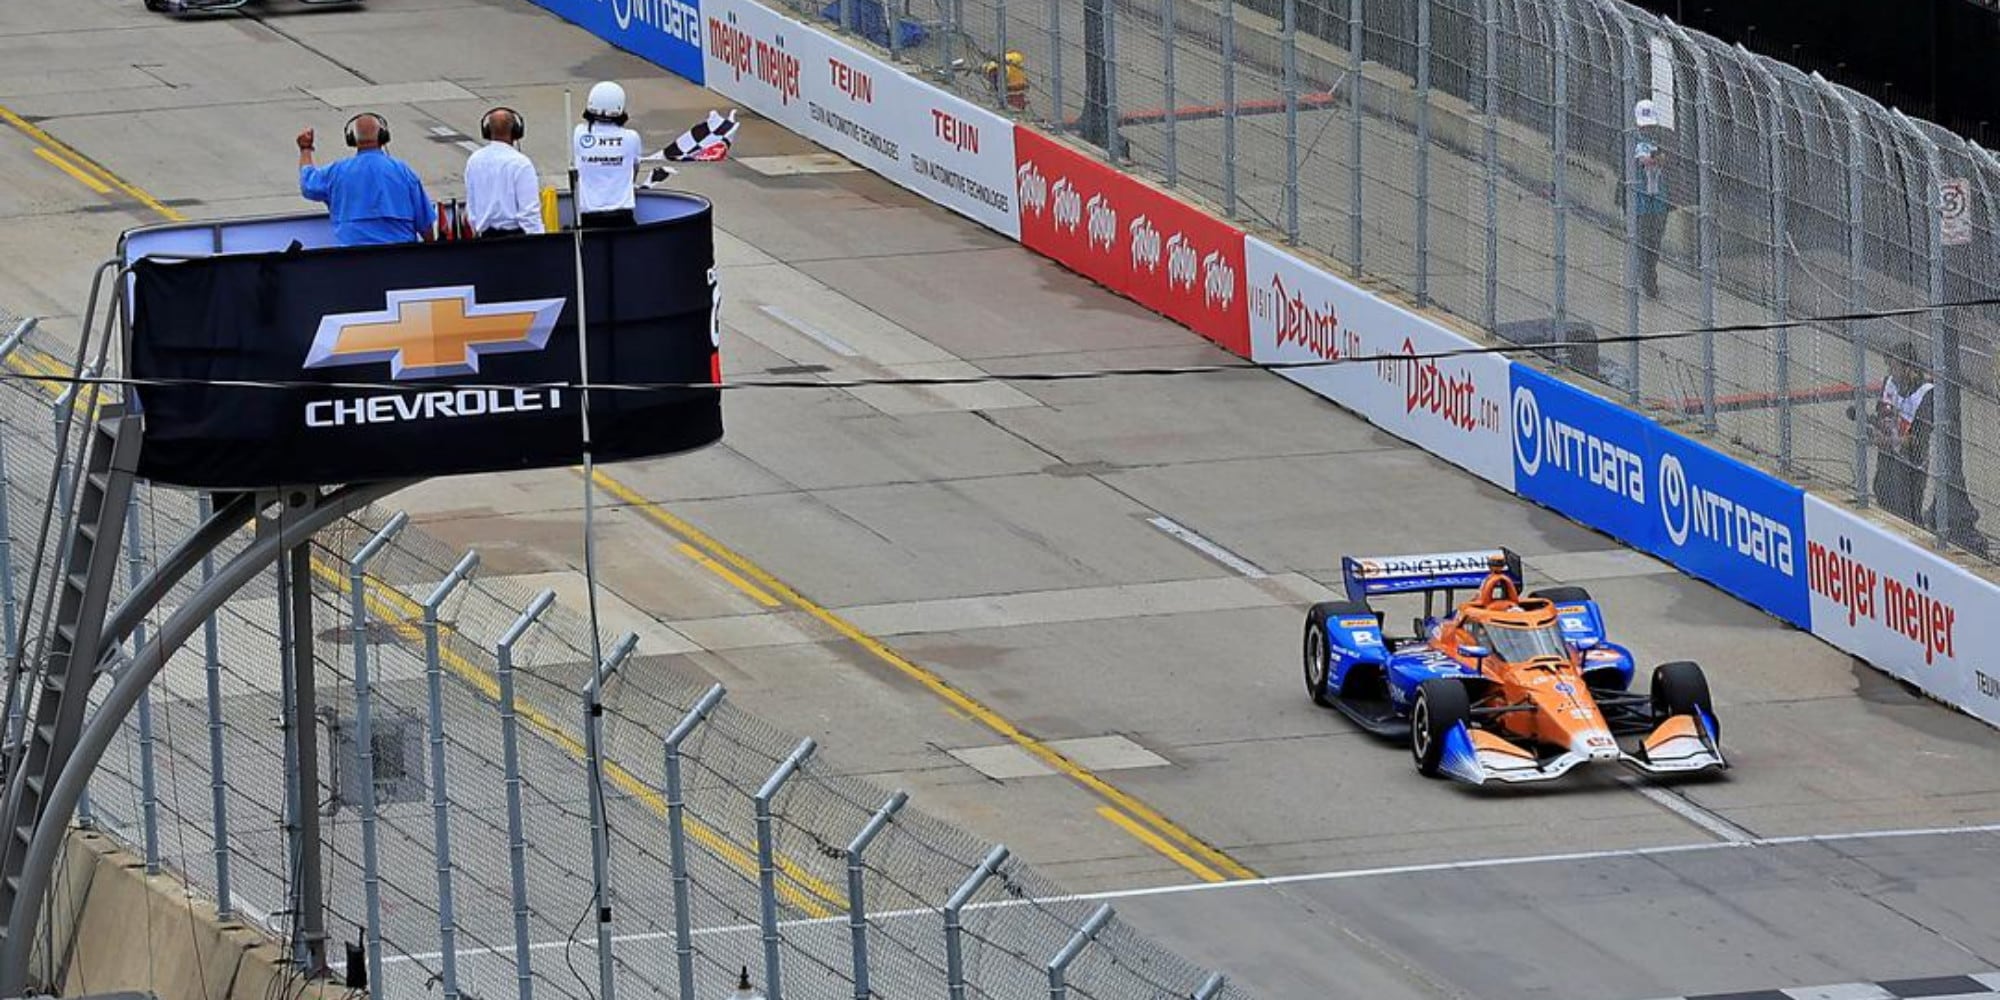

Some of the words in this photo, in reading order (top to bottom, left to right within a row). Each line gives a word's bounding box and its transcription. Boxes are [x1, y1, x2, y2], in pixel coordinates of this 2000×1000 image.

[709, 12, 752, 81] meijer
[756, 35, 801, 105] meijer
[829, 58, 871, 104] TEIJIN
[931, 109, 979, 154] TEIJIN
[305, 382, 569, 428] CHEVROLET
[1545, 416, 1586, 478] NTT
[1692, 484, 1733, 548] NTT
[1808, 535, 1876, 627] meijer
[1883, 571, 1955, 665] meijer
